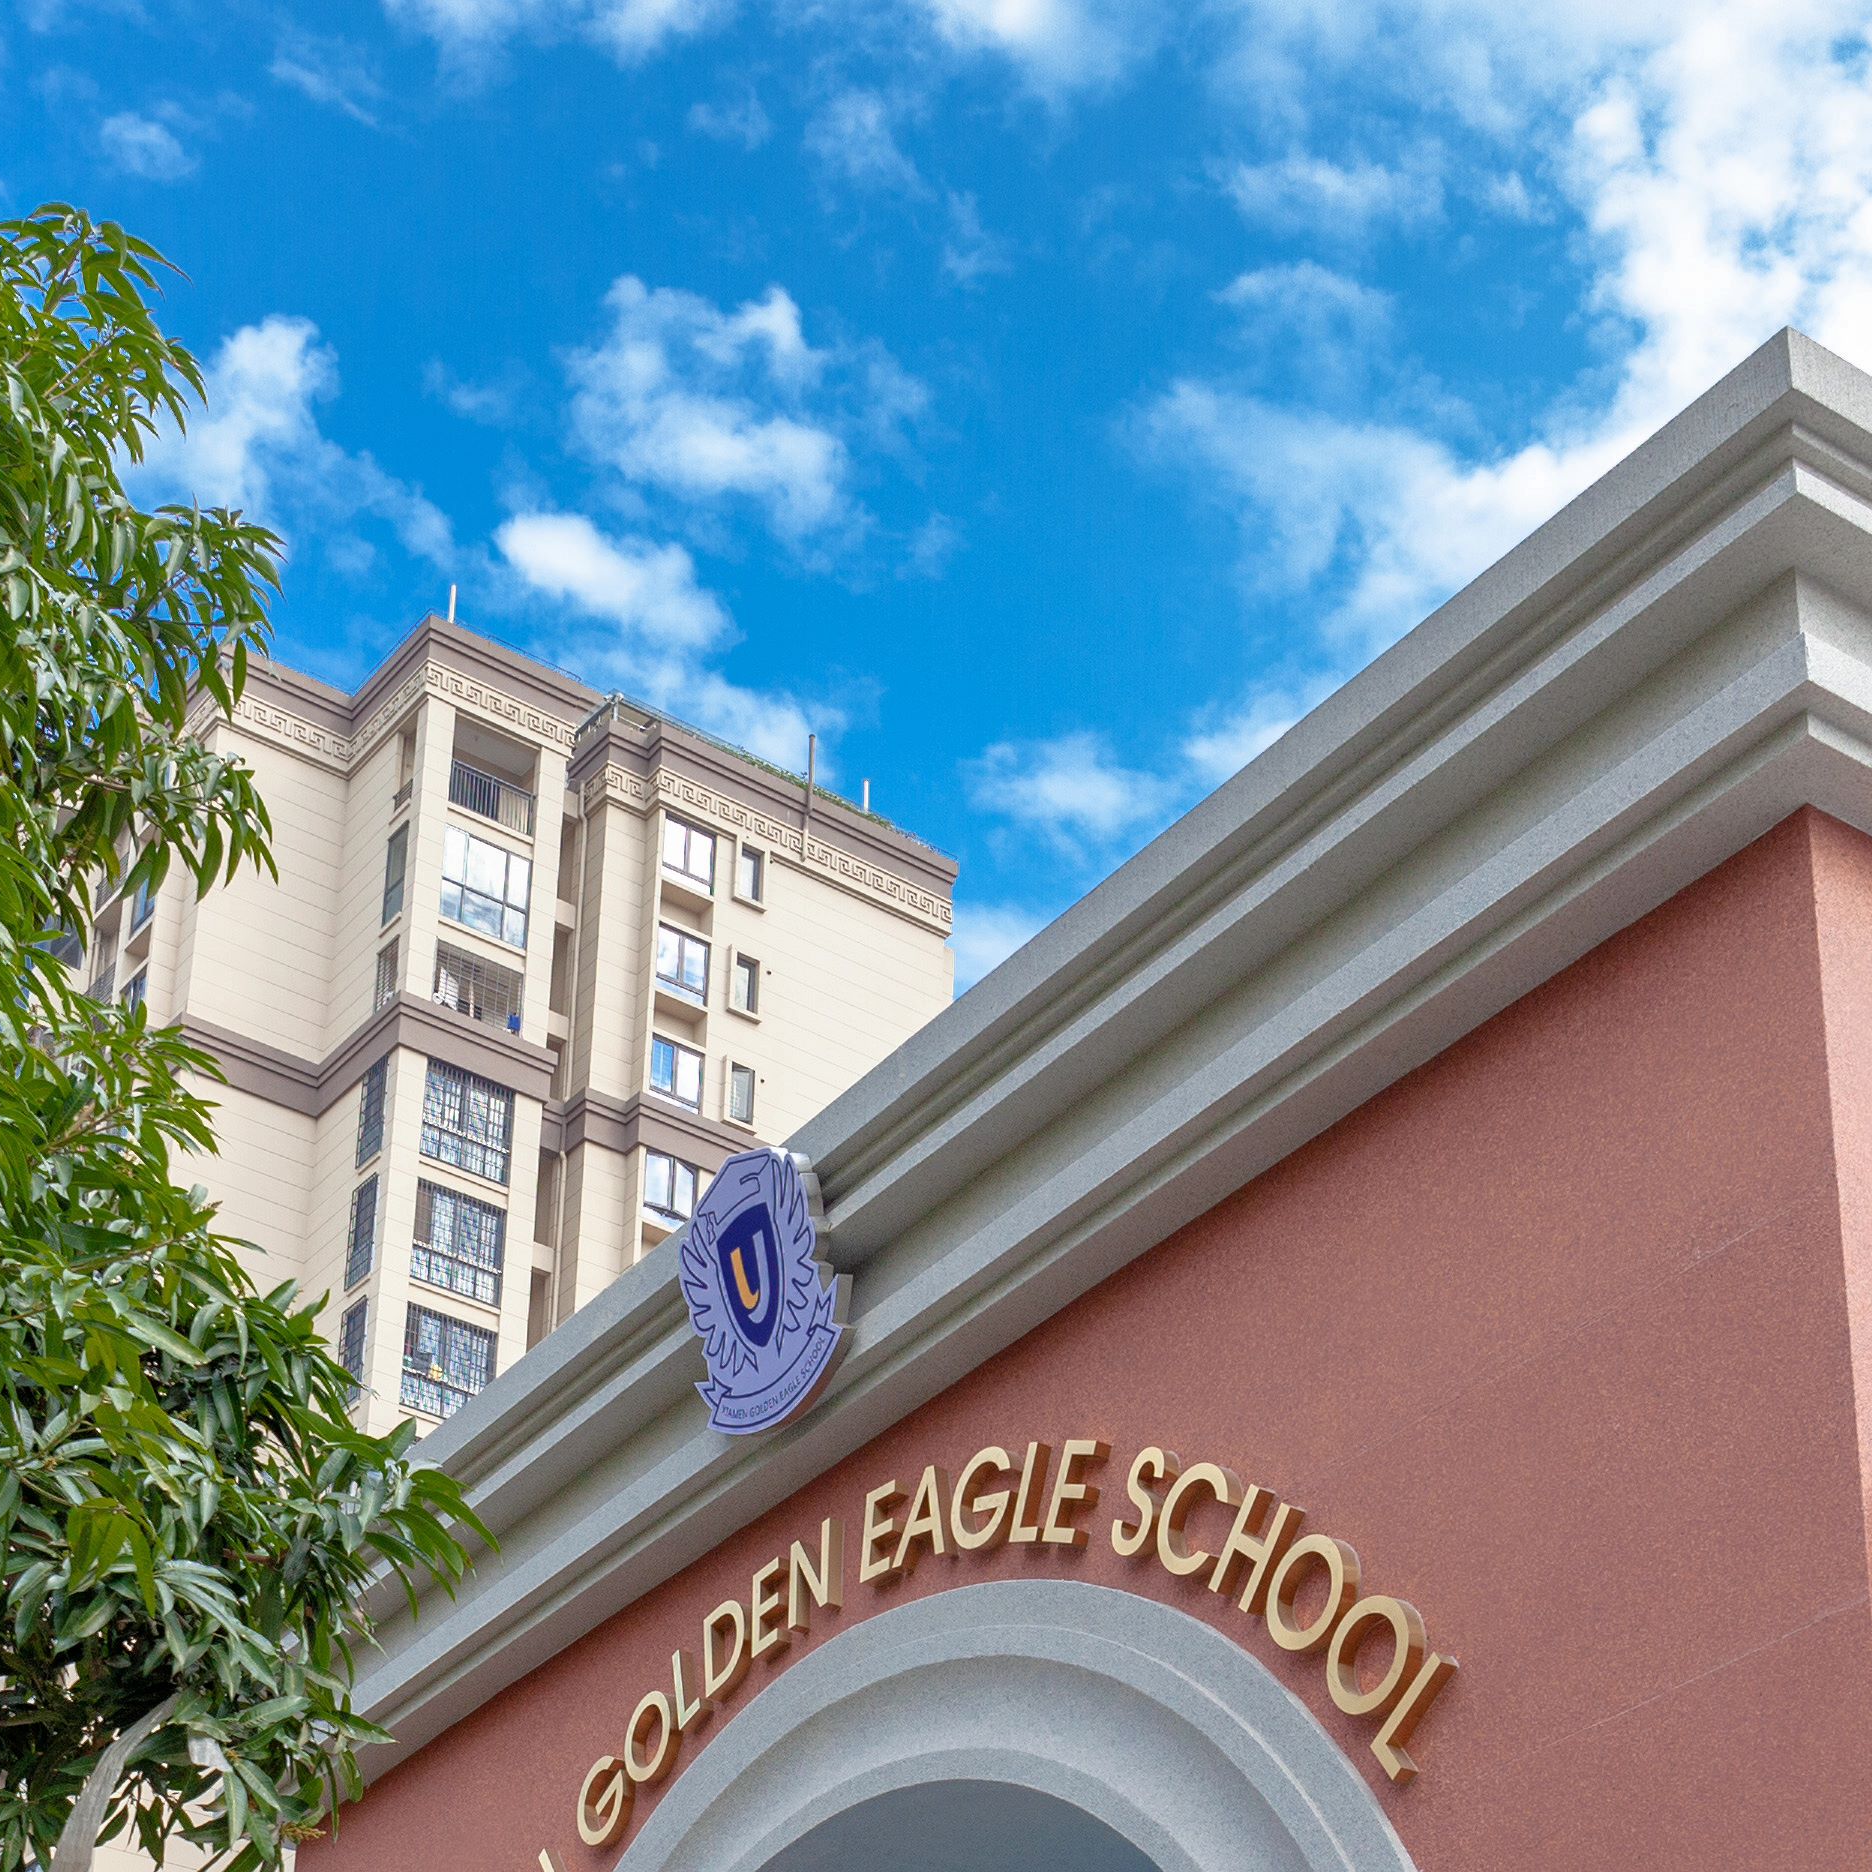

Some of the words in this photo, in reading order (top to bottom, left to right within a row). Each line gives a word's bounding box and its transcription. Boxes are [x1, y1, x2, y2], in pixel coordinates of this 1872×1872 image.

[749, 1395, 779, 1418] GOLDEN
[779, 1376, 802, 1401] EAGLE
[800, 1337, 826, 1379] SCHOOL
[577, 1517, 836, 1846] GOLDEN
[859, 1439, 1104, 1584] EAGLE
[1111, 1446, 1456, 1782] SCHOOL
